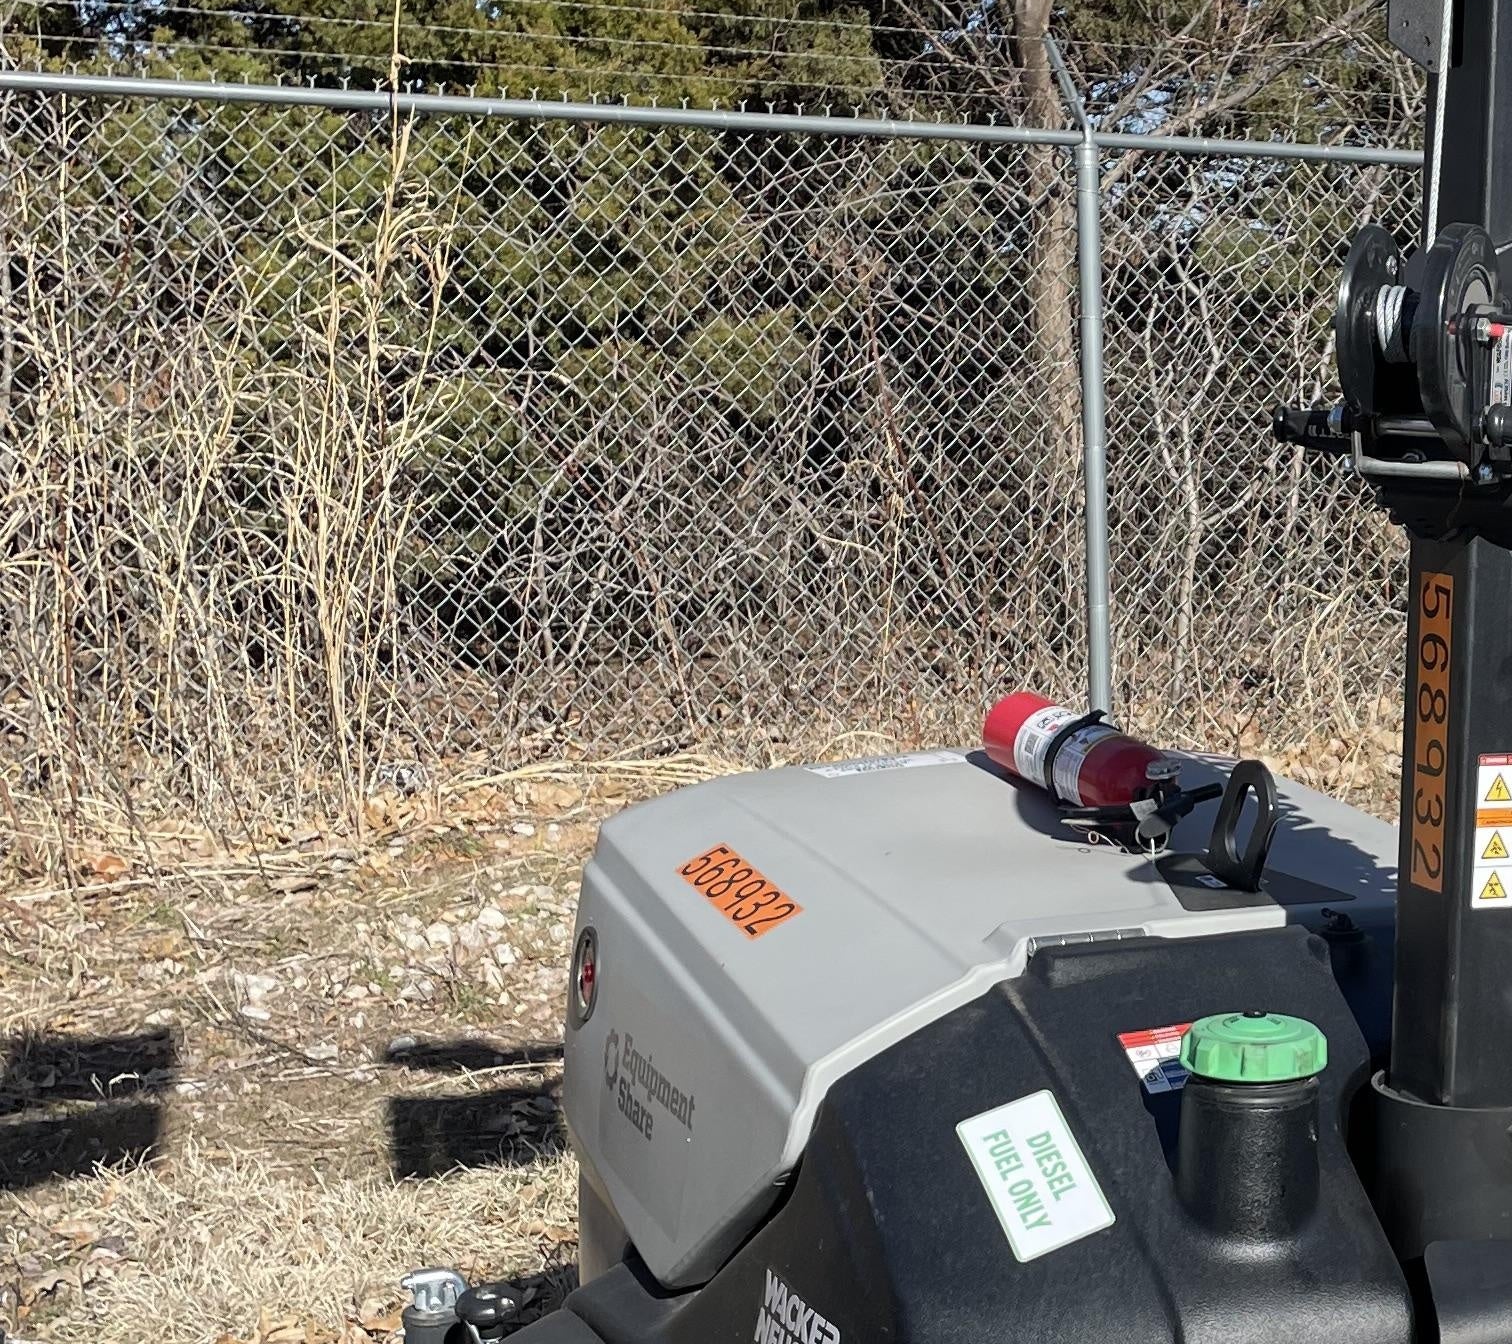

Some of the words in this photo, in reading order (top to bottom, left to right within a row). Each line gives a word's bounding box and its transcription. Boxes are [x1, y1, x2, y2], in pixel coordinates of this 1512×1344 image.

[1412, 580, 1451, 881] 568932
[681, 845, 796, 936] 568932
[617, 1078, 654, 1142] Share
[621, 1031, 696, 1132] Equipment
[982, 1128, 1025, 1182] FUEL
[1007, 1178, 1053, 1231] ONLY
[1025, 1130, 1078, 1202] DIESEL
